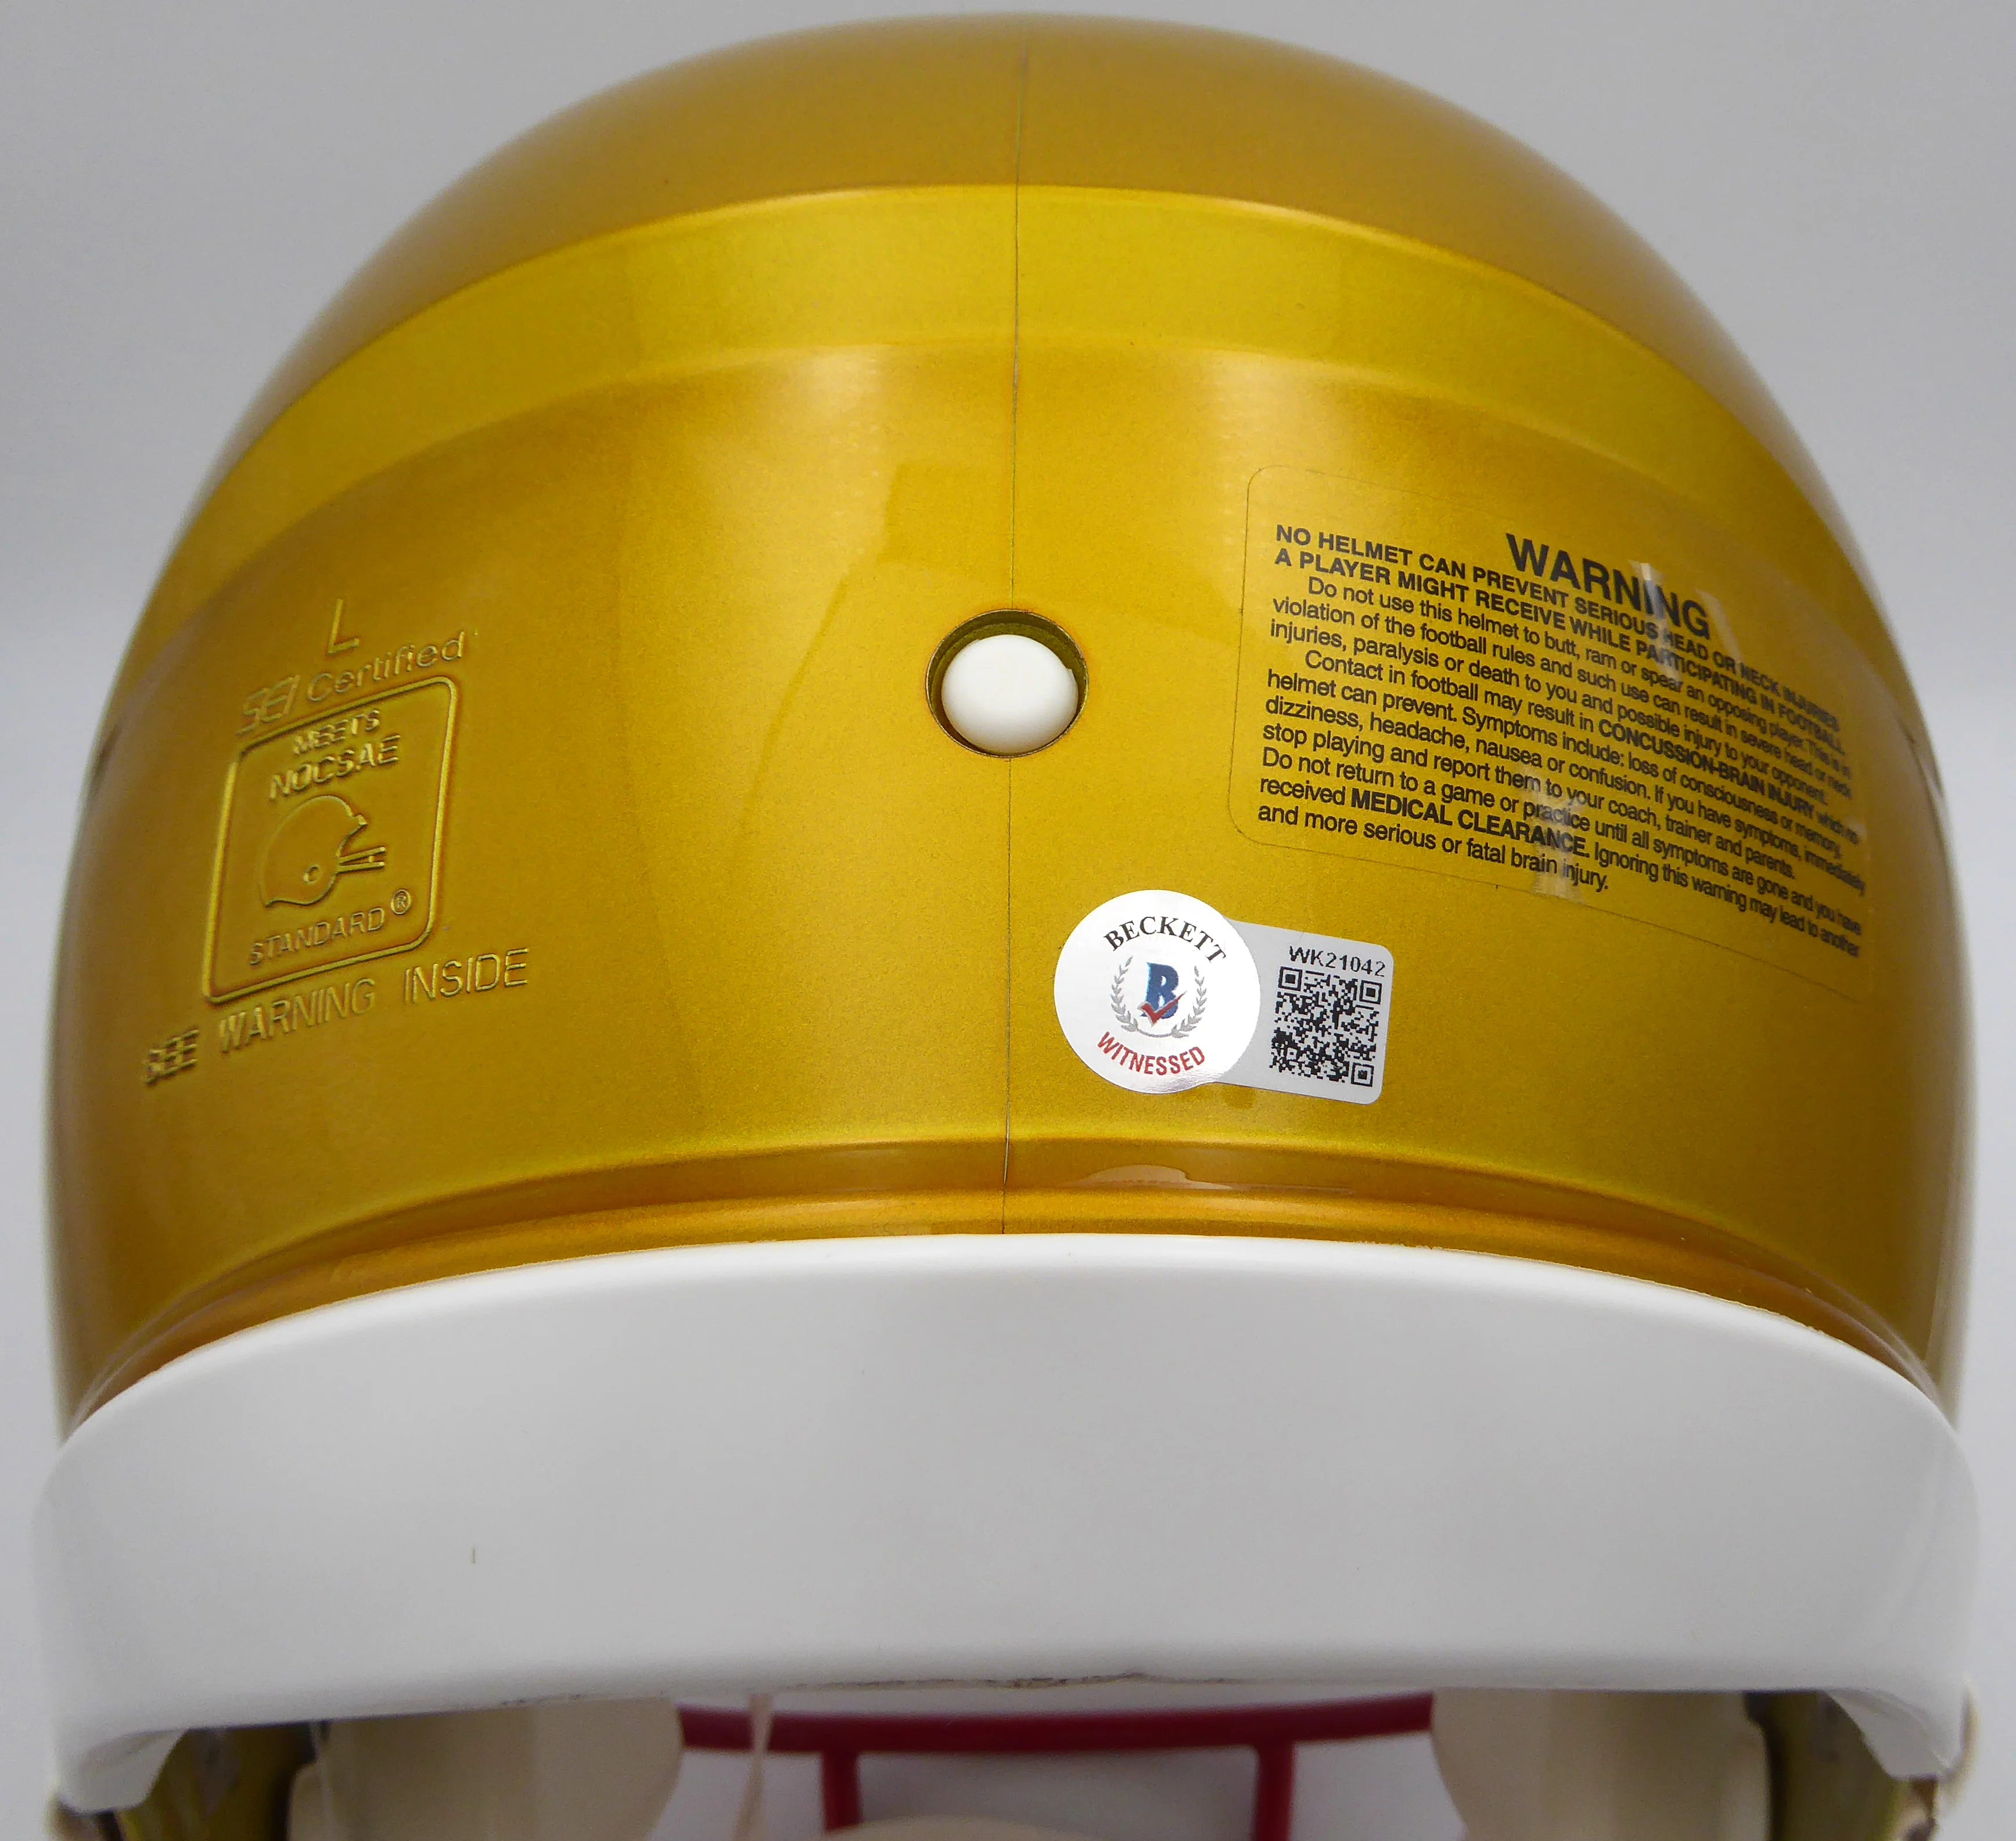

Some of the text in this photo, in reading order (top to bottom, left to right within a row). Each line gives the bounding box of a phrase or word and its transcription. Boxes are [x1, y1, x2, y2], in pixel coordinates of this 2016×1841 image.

[326, 599, 360, 654] L
[1275, 548, 1291, 566] A
[1300, 551, 1390, 585] PLAYER
[1398, 571, 1469, 602] MIGHT
[1476, 590, 1565, 630] RECEIVE
[1569, 616, 1630, 652] WHILE
[1761, 694, 1774, 713] IN
[1277, 525, 1310, 546] NO
[1319, 532, 1413, 566] HELMET
[1419, 554, 1465, 580] CAN
[1473, 566, 1569, 608] PREVENT
[1575, 597, 1658, 640] SERIOUS
[1713, 651, 1735, 674] OR
[1309, 576, 1336, 598] Do
[1343, 587, 1374, 605] not
[1379, 594, 1414, 613] use
[1420, 600, 1452, 622] this
[1458, 608, 1519, 640] helmet
[1523, 626, 1540, 644] to
[1545, 631, 1580, 659] butt,
[1586, 649, 1616, 669] ram
[1621, 661, 1637, 676] or
[1641, 668, 1683, 692] spear
[1687, 686, 1704, 702] an
[1506, 533, 1710, 640] WARNING
[307, 631, 464, 701] Certified
[1271, 619, 1346, 651] injuries,
[1354, 637, 1439, 667] paralysis
[1444, 657, 1462, 672] or
[1468, 660, 1519, 687] death
[1525, 674, 1541, 692] to
[1546, 683, 1577, 704] you
[1582, 694, 1612, 715] and
[1618, 705, 1680, 737] possible
[1684, 725, 1721, 757] injury
[1725, 743, 1738, 760] to
[1741, 752, 1769, 774] your
[1274, 597, 1354, 625] violation
[1361, 613, 1379, 630] of
[1385, 616, 1415, 637] the
[1420, 623, 1486, 655] football
[1493, 644, 1535, 667] rules
[1540, 658, 1572, 678] and
[1577, 669, 1615, 691] such
[1621, 683, 1649, 703] use
[1653, 695, 1680, 715] can
[1684, 706, 1722, 733] result
[1726, 720, 1737, 738] in
[1306, 650, 1383, 681] Contact
[1389, 669, 1404, 685] in
[1411, 670, 1478, 701] football
[1484, 690, 1522, 716] may
[1528, 702, 1575, 727] result
[1580, 713, 1593, 732] in
[269, 734, 401, 800] NOCSAE
[294, 709, 380, 755] MEETS
[1266, 695, 1363, 731] dizziness,
[1370, 712, 1469, 753] headache,
[1476, 738, 1543, 768] nausea
[1547, 758, 1565, 773] or
[1569, 763, 1650, 799] confusion.
[1655, 785, 1663, 803] If
[1667, 794, 1694, 814] you
[1698, 800, 1731, 828] have
[1268, 669, 1336, 698] helmet
[1341, 686, 1377, 705] can
[1383, 693, 1457, 722] prevent.
[1462, 706, 1557, 747] Symptoms
[1562, 731, 1624, 767] include:
[1629, 752, 1659, 777] loss
[1663, 767, 1677, 784] of
[1781, 816, 1792, 831] or
[1263, 723, 1307, 748] stop
[1313, 731, 1384, 763] playing
[1390, 747, 1428, 767] and
[1433, 755, 1490, 781] report
[1494, 766, 1540, 791] them
[1546, 778, 1562, 798] to
[1566, 787, 1605, 809] your
[1608, 800, 1661, 830] coach,
[1665, 814, 1713, 844] trainer
[1716, 836, 1742, 857] and
[1263, 747, 1292, 769] Do
[1299, 757, 1331, 776] not
[1336, 763, 1394, 787] return
[1399, 771, 1418, 791] to
[1423, 780, 1436, 795] a
[1441, 784, 1495, 808] game
[1500, 796, 1519, 813] or
[1523, 802, 1590, 831] practice
[1595, 821, 1627, 842] until
[1632, 831, 1649, 849] all
[1653, 839, 1728, 876] symptoms
[1732, 866, 1754, 885] are
[1757, 877, 1788, 899] gone
[1791, 891, 1813, 911] and
[1258, 806, 1608, 892] and more serious or fatal brain injury.
[1260, 778, 1346, 805] received
[1351, 788, 1453, 826] MEDICAL
[1457, 809, 1590, 858] CLEARANCE.
[1594, 842, 1658, 882] Ignoring
[1662, 864, 1688, 887] this
[1692, 877, 1747, 912] warning
[1750, 898, 1777, 923] may
[249, 906, 385, 966] STANDARD
[1104, 916, 1226, 964] BECKETT
[1289, 945, 1386, 977] WK21042
[219, 977, 375, 1053] WARNING
[404, 948, 529, 1004] INSIDE
[1097, 1031, 1205, 1075] WITNESSED
